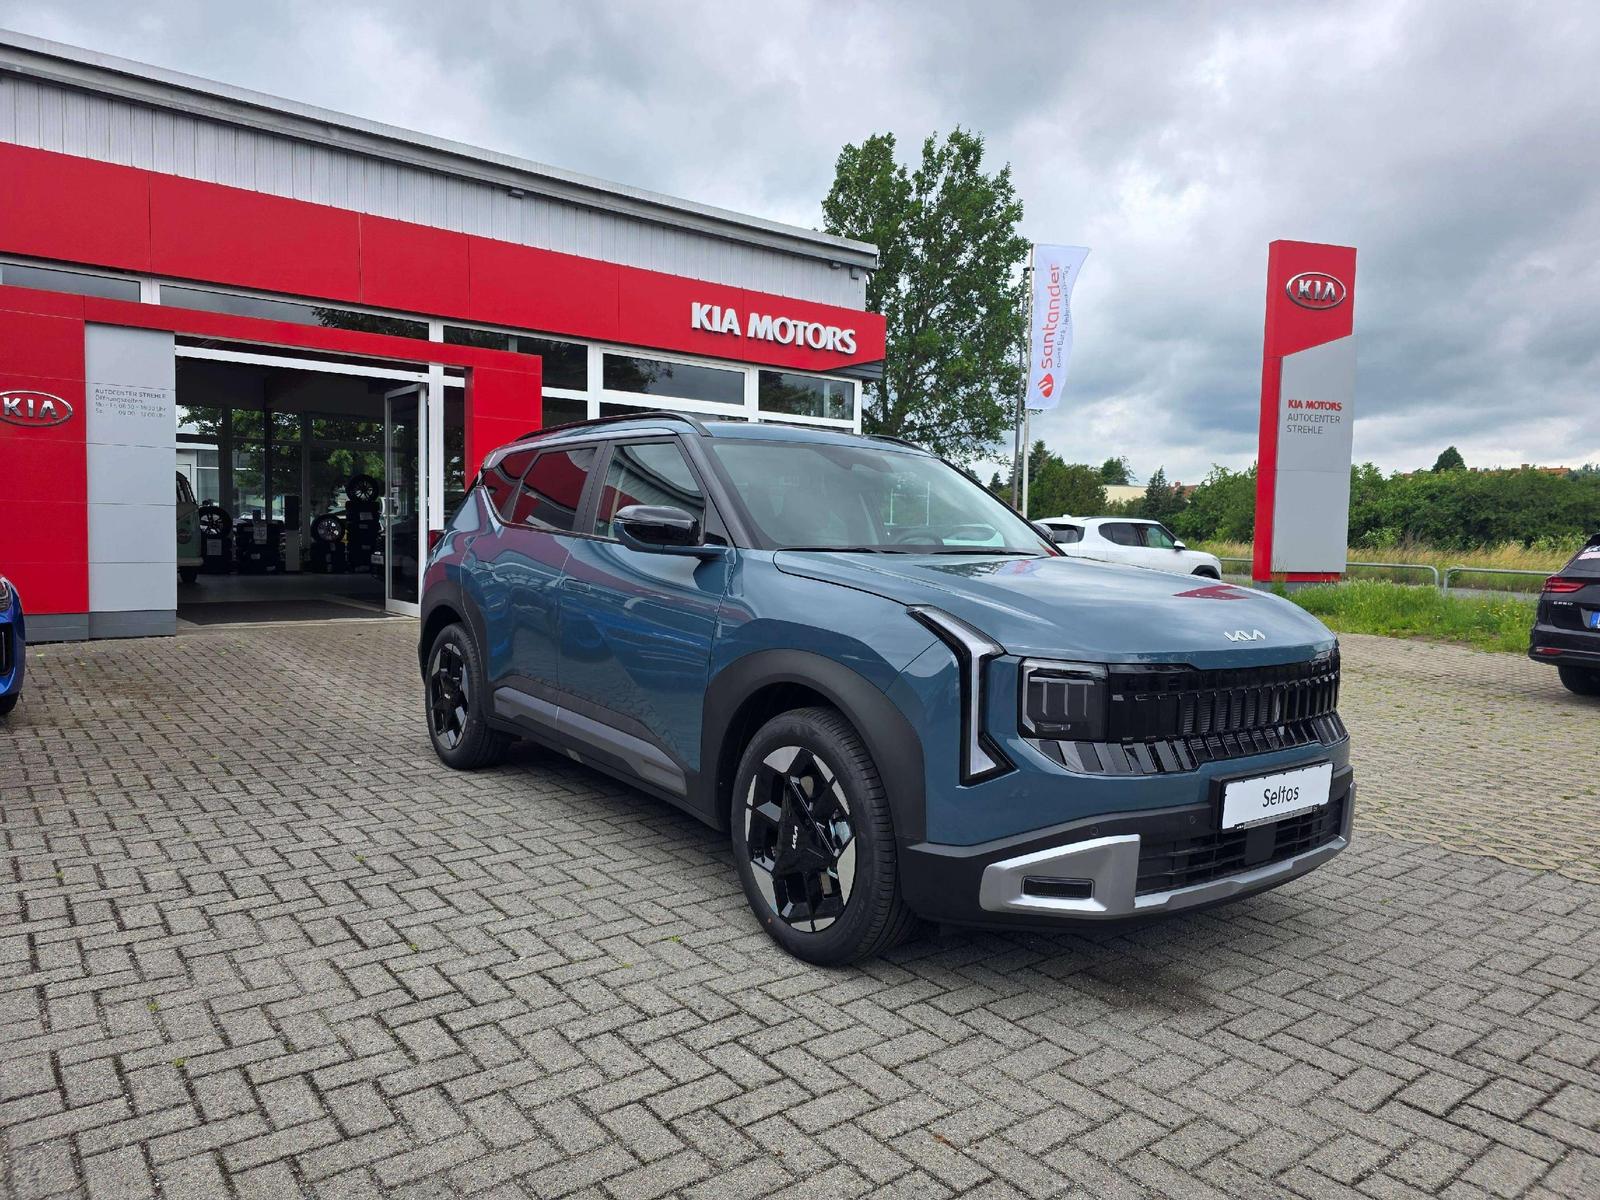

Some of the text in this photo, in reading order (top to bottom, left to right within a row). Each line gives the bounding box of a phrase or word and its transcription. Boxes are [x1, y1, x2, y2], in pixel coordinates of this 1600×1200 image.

[1297, 279, 1336, 302] KIA
[1041, 264, 1061, 369] Santander
[691, 302, 857, 355] KIA MOTORS
[2, 396, 59, 419] KIA
[1287, 399, 1343, 412] KIA MOTORS
[1286, 424, 1323, 435] STREHLE
[1287, 413, 1341, 424] AUTOCENTER
[1223, 629, 1266, 642] KIA
[1262, 785, 1300, 808] Seltos
